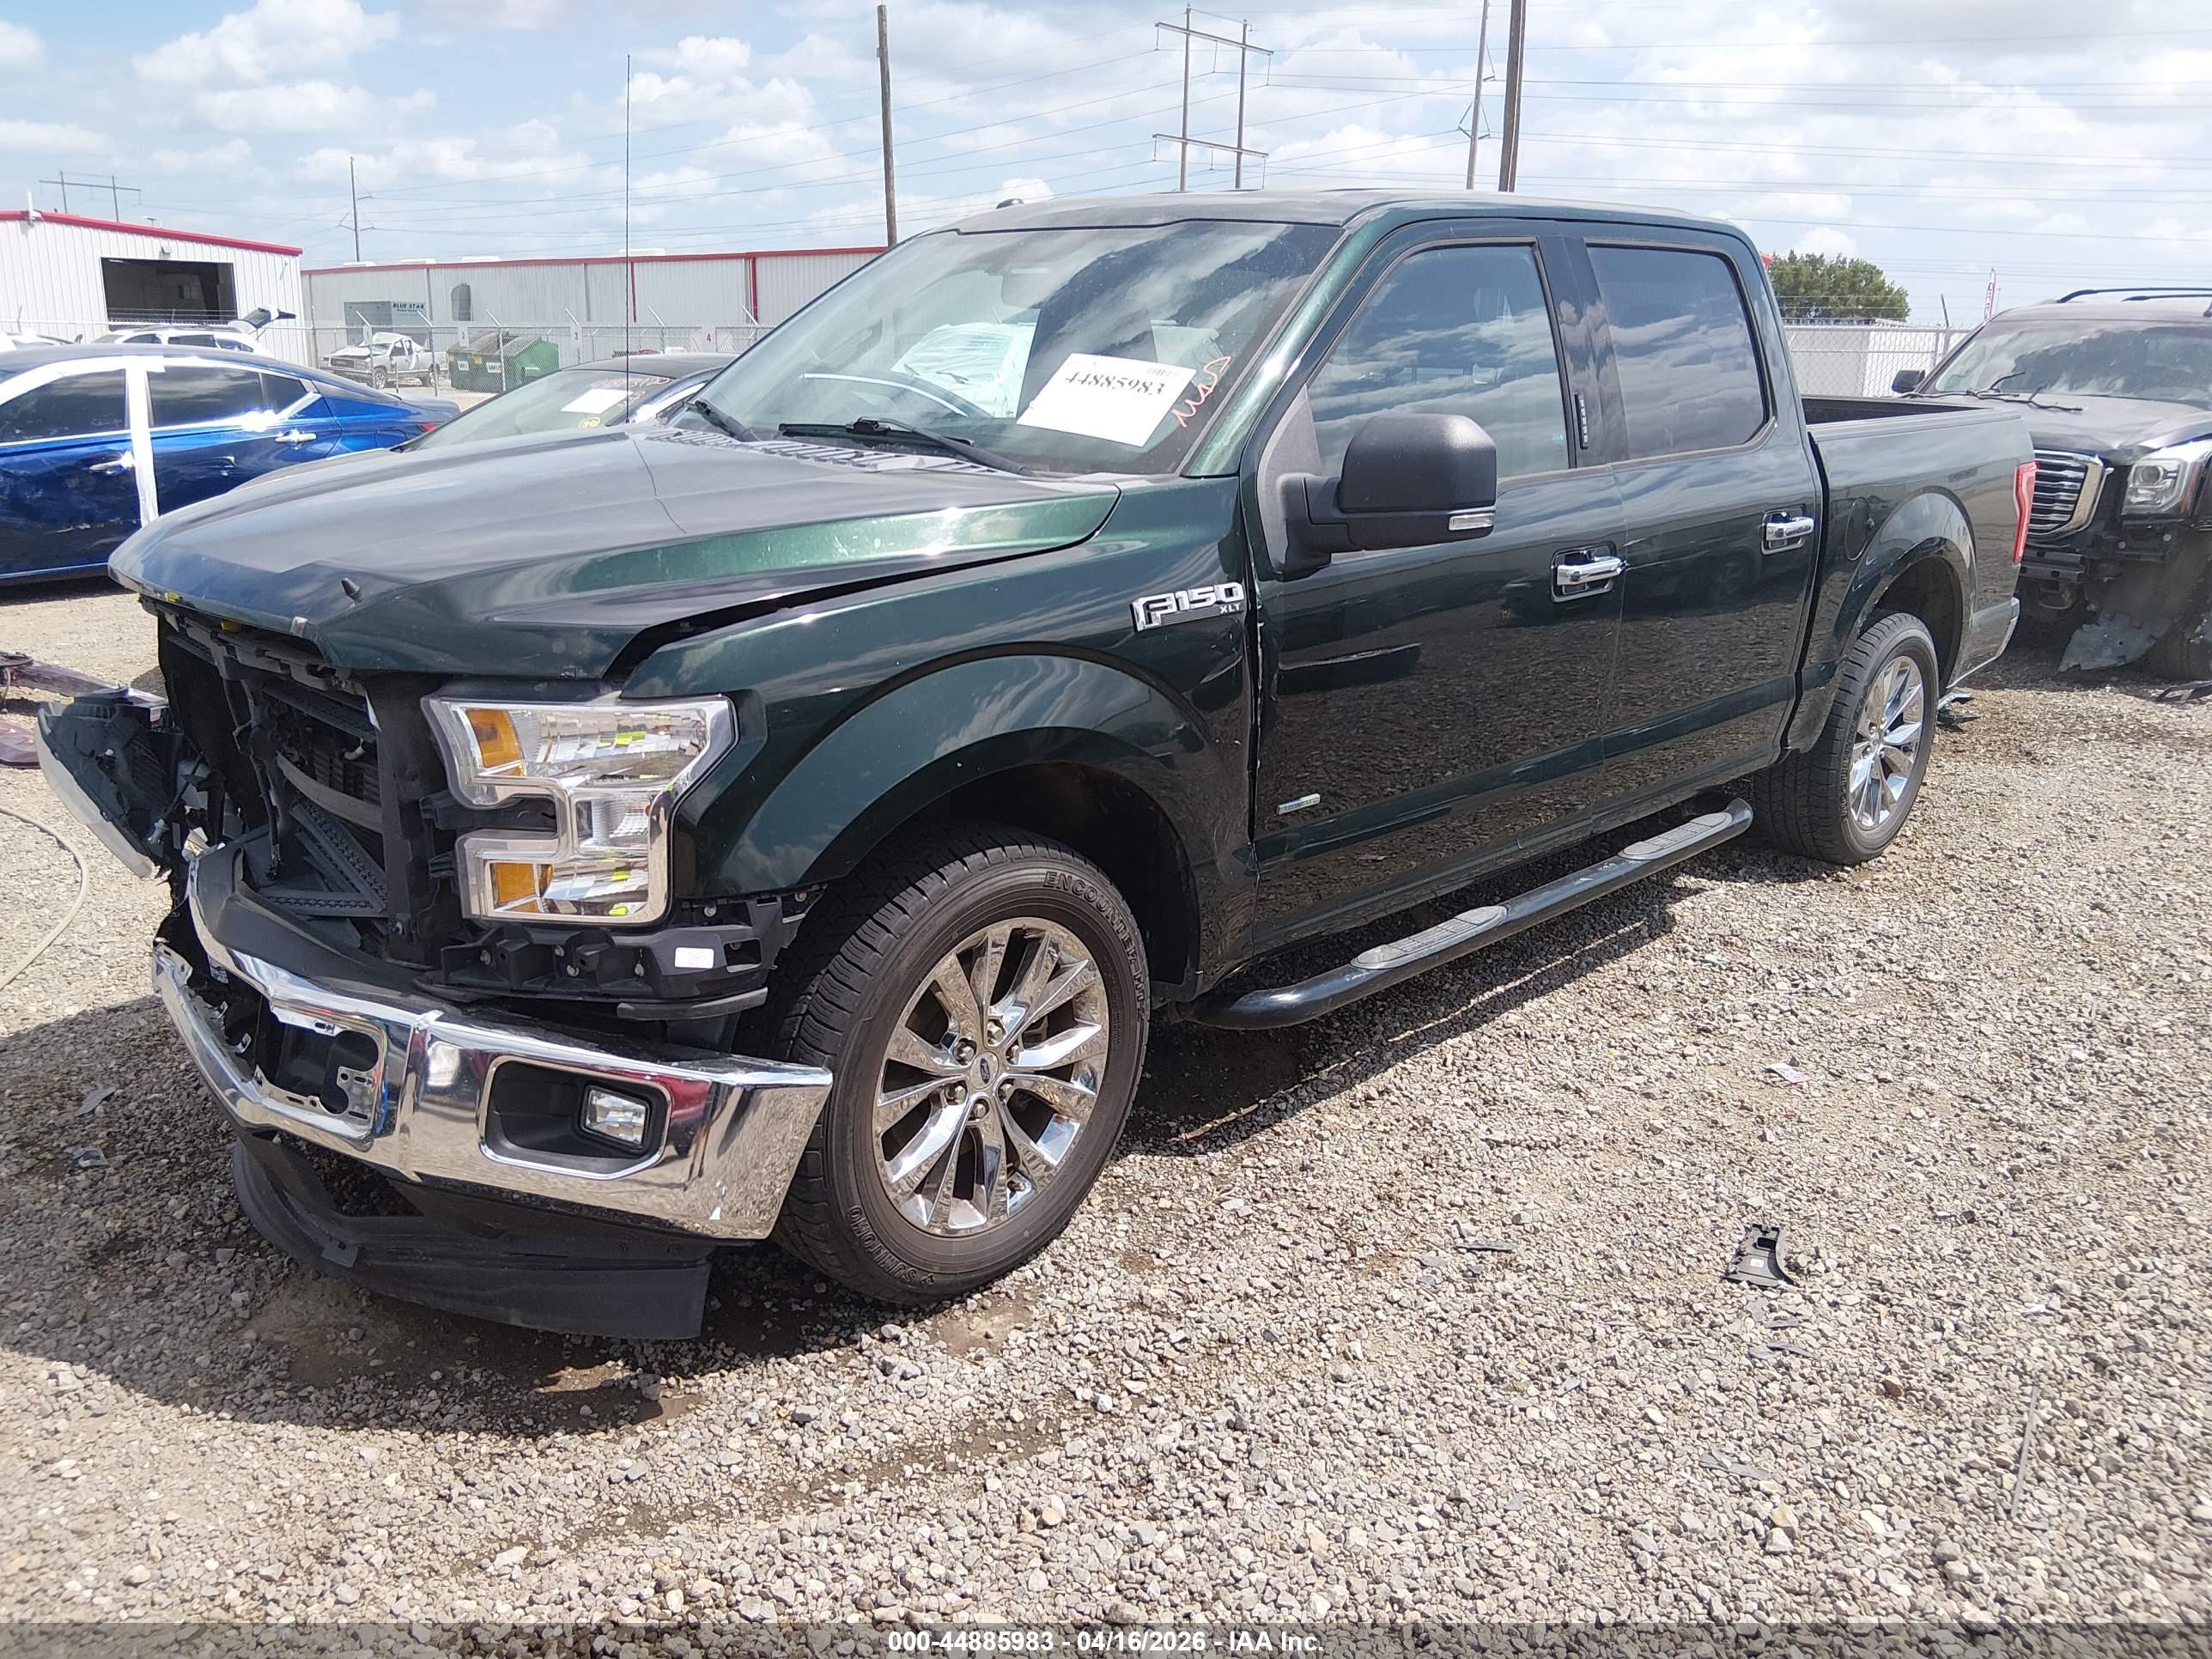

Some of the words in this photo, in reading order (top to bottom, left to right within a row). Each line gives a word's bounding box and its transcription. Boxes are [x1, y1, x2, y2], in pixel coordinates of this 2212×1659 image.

[707, 332, 712, 343] 4
[1065, 371, 1165, 396] 44885983
[1219, 603, 1241, 614] XLT
[1042, 871, 1139, 964] ENCOUNTER
[847, 1205, 917, 1283] SUMITOMO
